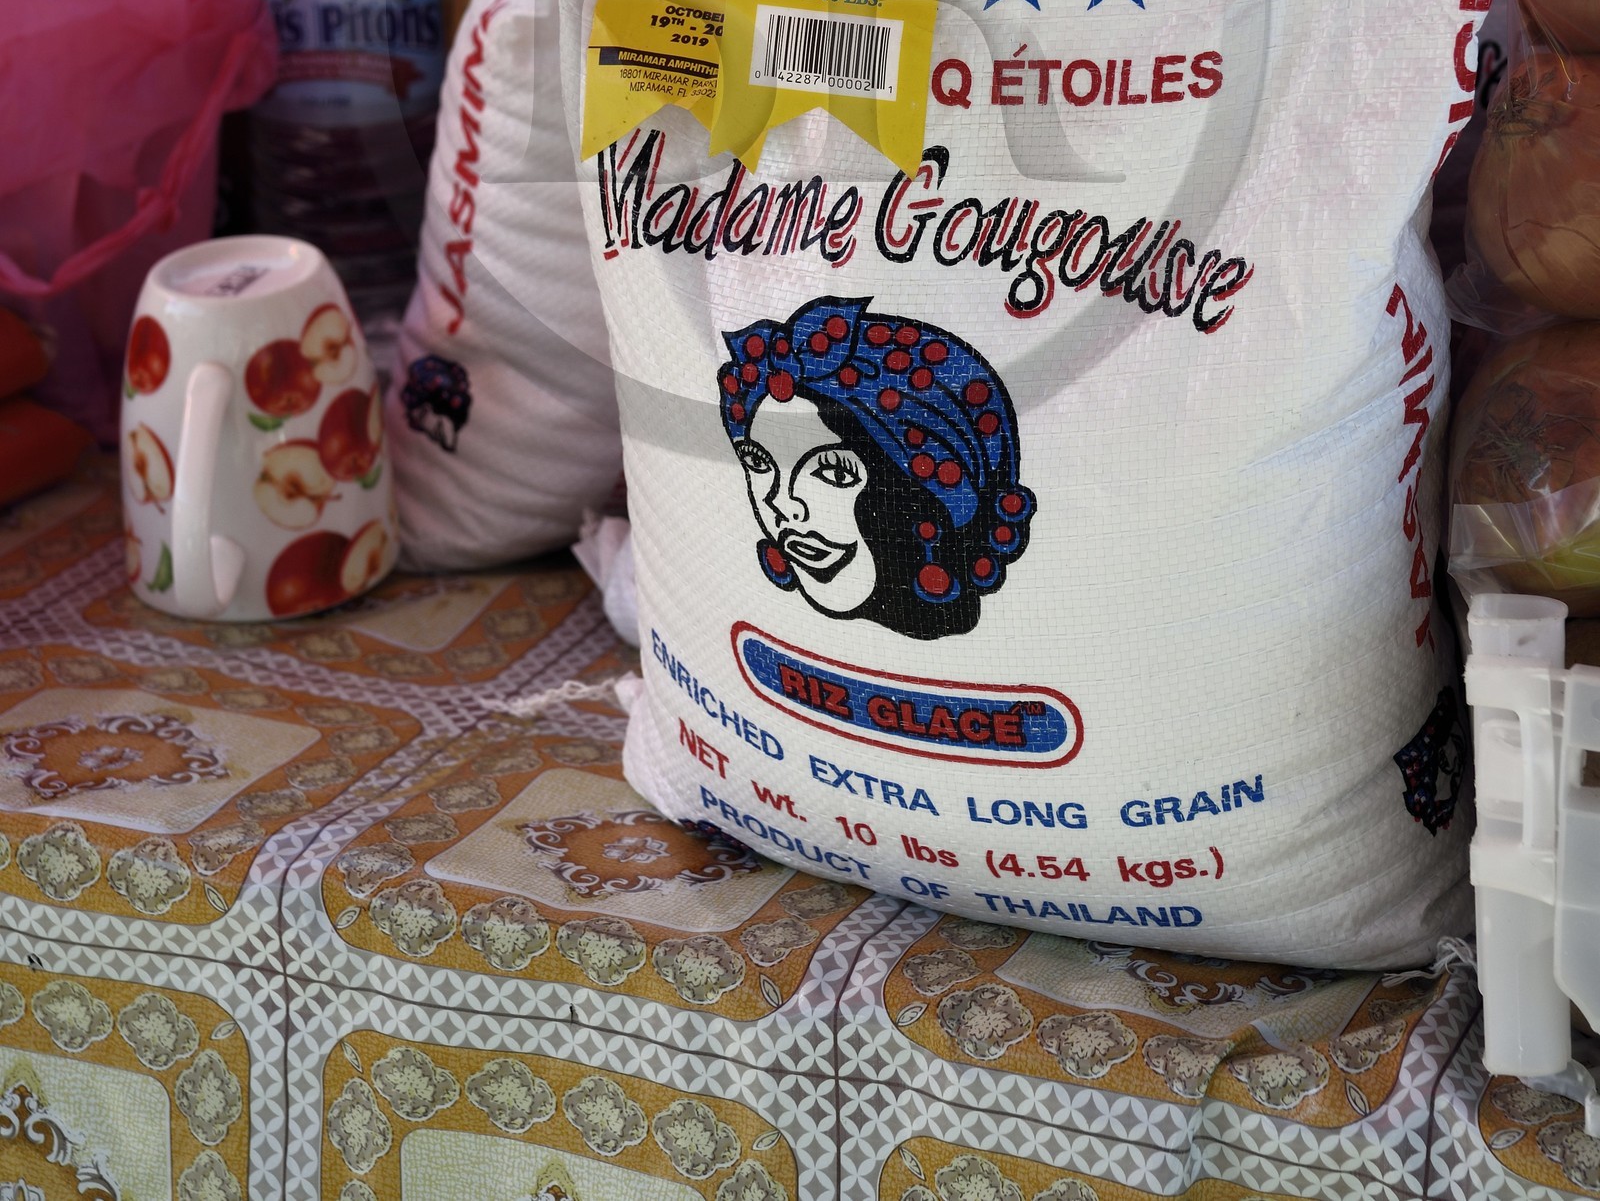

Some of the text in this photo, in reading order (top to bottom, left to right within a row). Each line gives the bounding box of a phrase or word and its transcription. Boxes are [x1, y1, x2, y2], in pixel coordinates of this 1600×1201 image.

[321, 2, 441, 45] Pitons
[670, 33, 709, 47] 2019
[618, 50, 668, 67] MIRAMAR
[643, 70, 689, 86] MIRAMAR
[691, 79, 718, 89] PARK
[990, 43, 1224, 107] ÉTOILES
[629, 81, 674, 96] MIRAMAR,
[597, 128, 864, 269] Madame
[778, 662, 855, 721] RIZ
[650, 627, 1266, 830] ENRICHED EXTRA LONG GRAIN
[678, 716, 730, 780] NET
[834, 815, 878, 847] 10
[900, 834, 960, 868] lbs
[985, 849, 1091, 882] (4.54
[1116, 845, 1225, 888] kgs.)
[699, 783, 1204, 928] PRODUCT OF THAILAND
